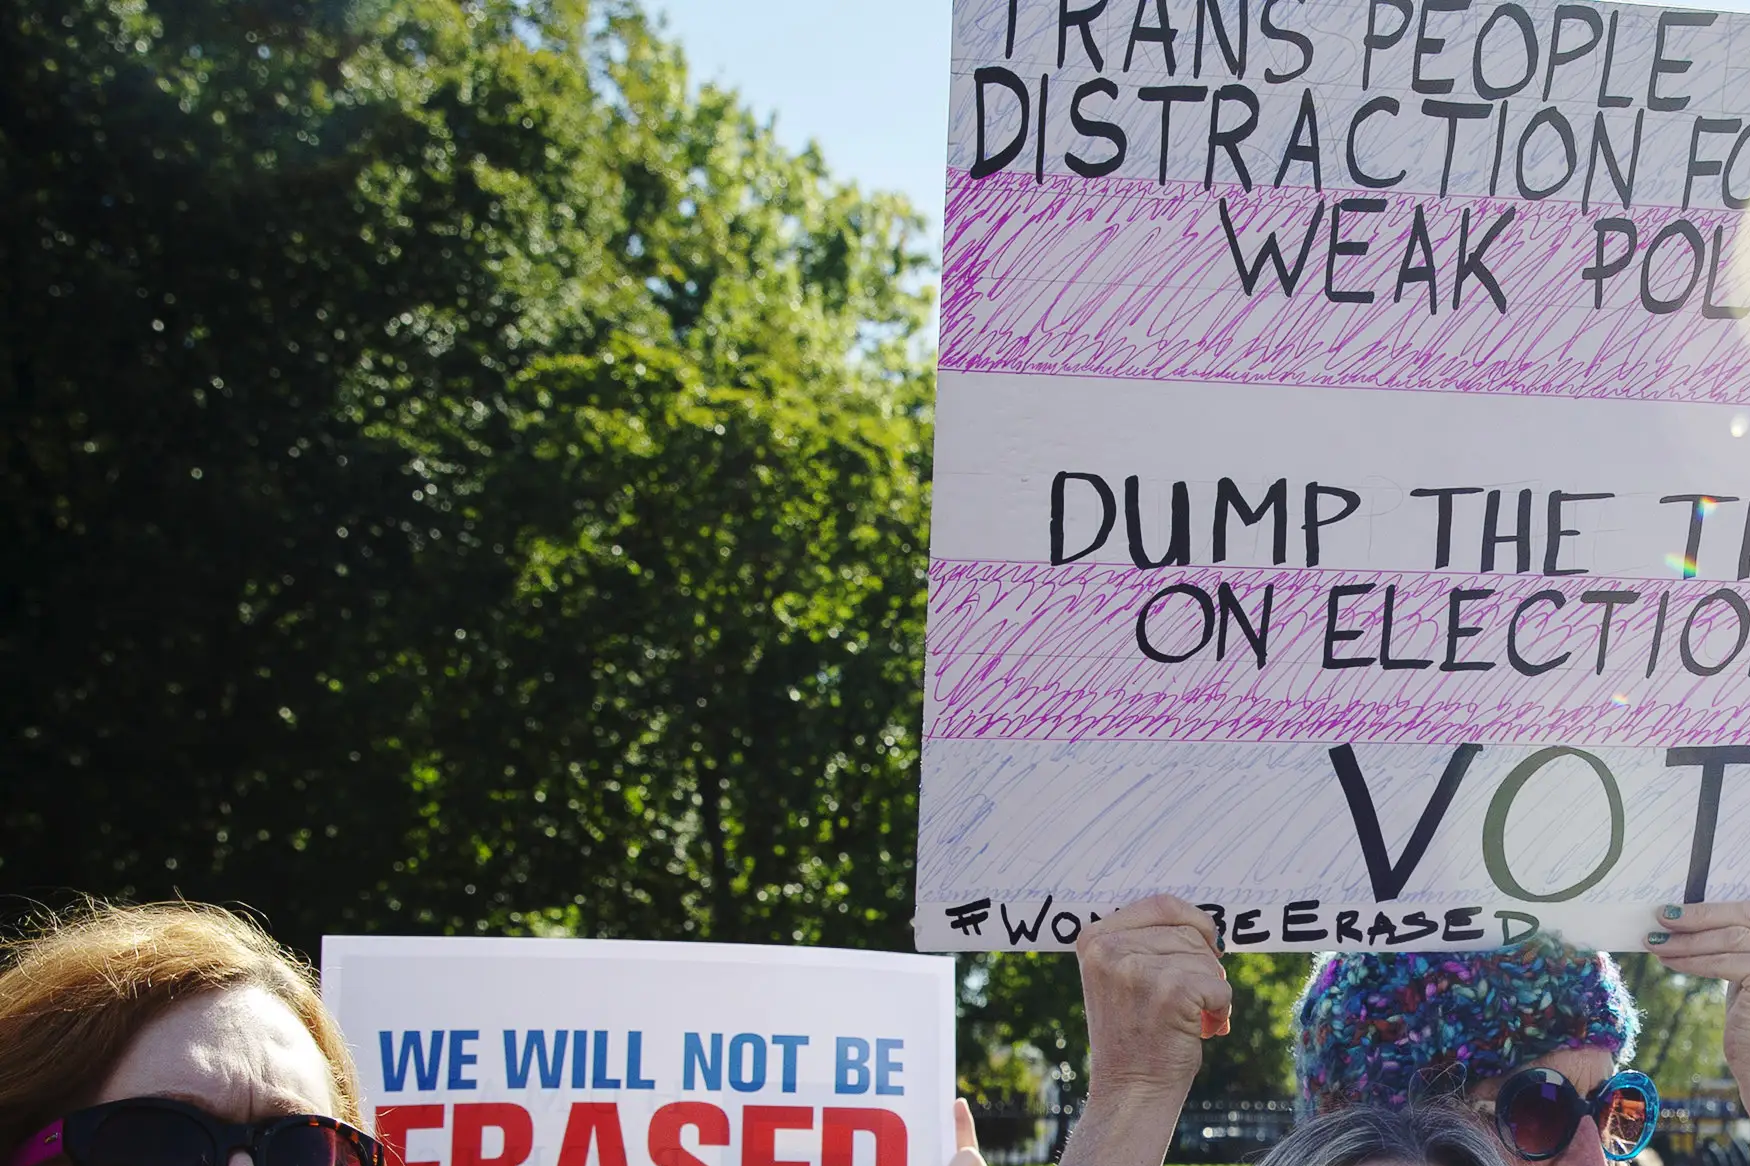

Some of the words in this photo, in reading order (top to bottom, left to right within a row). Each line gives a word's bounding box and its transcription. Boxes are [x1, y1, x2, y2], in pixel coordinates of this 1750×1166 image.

[1362, 1, 1718, 110] PEOPLE
[969, 66, 1645, 213] DISTRACTION
[1220, 198, 1516, 315] WEAK
[1050, 470, 1361, 570] DUMP
[1409, 486, 1614, 576] THE
[1136, 581, 1275, 669] ON
[379, 1029, 480, 1093] WE
[503, 1029, 656, 1092] WILL
[683, 1032, 810, 1095] NOT
[835, 1036, 905, 1096] BE
